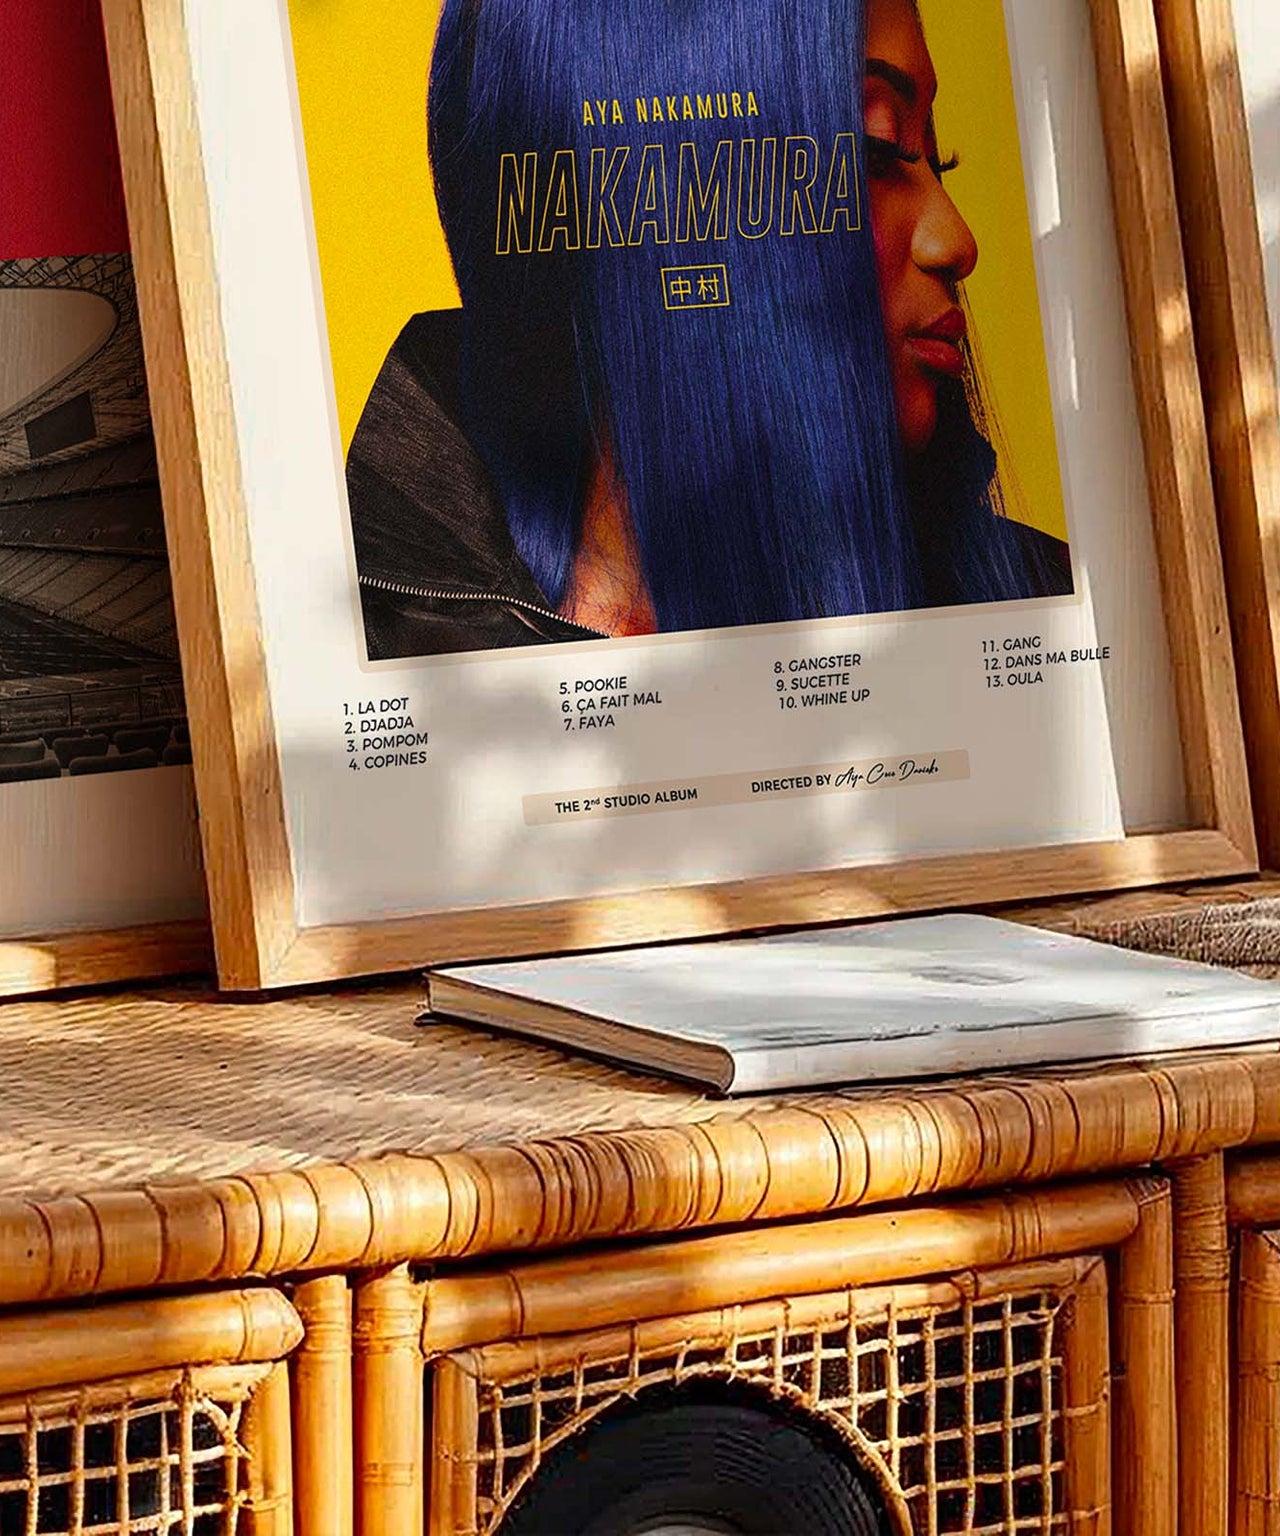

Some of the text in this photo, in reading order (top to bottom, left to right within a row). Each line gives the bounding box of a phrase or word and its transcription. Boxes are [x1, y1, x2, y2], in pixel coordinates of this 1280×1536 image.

[583, 91, 759, 126] AYA NAKAMURA
[495, 132, 862, 255] NAKAMURA
[670, 274, 720, 304] 中村
[981, 635, 1042, 654] 11. GANG
[773, 653, 862, 674] 8. GANGSTER
[983, 645, 1111, 672] 12. DANS MA BULLE
[559, 676, 627, 695] 5. POOKIE
[775, 672, 851, 693] 9. SUCETTE
[985, 670, 1045, 689] 13. OULA
[343, 697, 410, 716] 1. LA DOT
[560, 691, 663, 716] 6. ÇA FAIT MAL
[779, 688, 871, 710] 10. WHINE UP
[344, 715, 415, 735] 2. DJADJA
[563, 713, 616, 732] 7. FAYA
[346, 732, 428, 753] 3. POMPOM
[348, 750, 428, 771] 4. COPINES
[751, 776, 813, 793] DIRECTED
[816, 774, 831, 786] BY
[835, 767, 863, 787] Aya
[554, 799, 581, 814] THE
[603, 792, 652, 810] STUDIO
[654, 787, 699, 804] ALBUM
